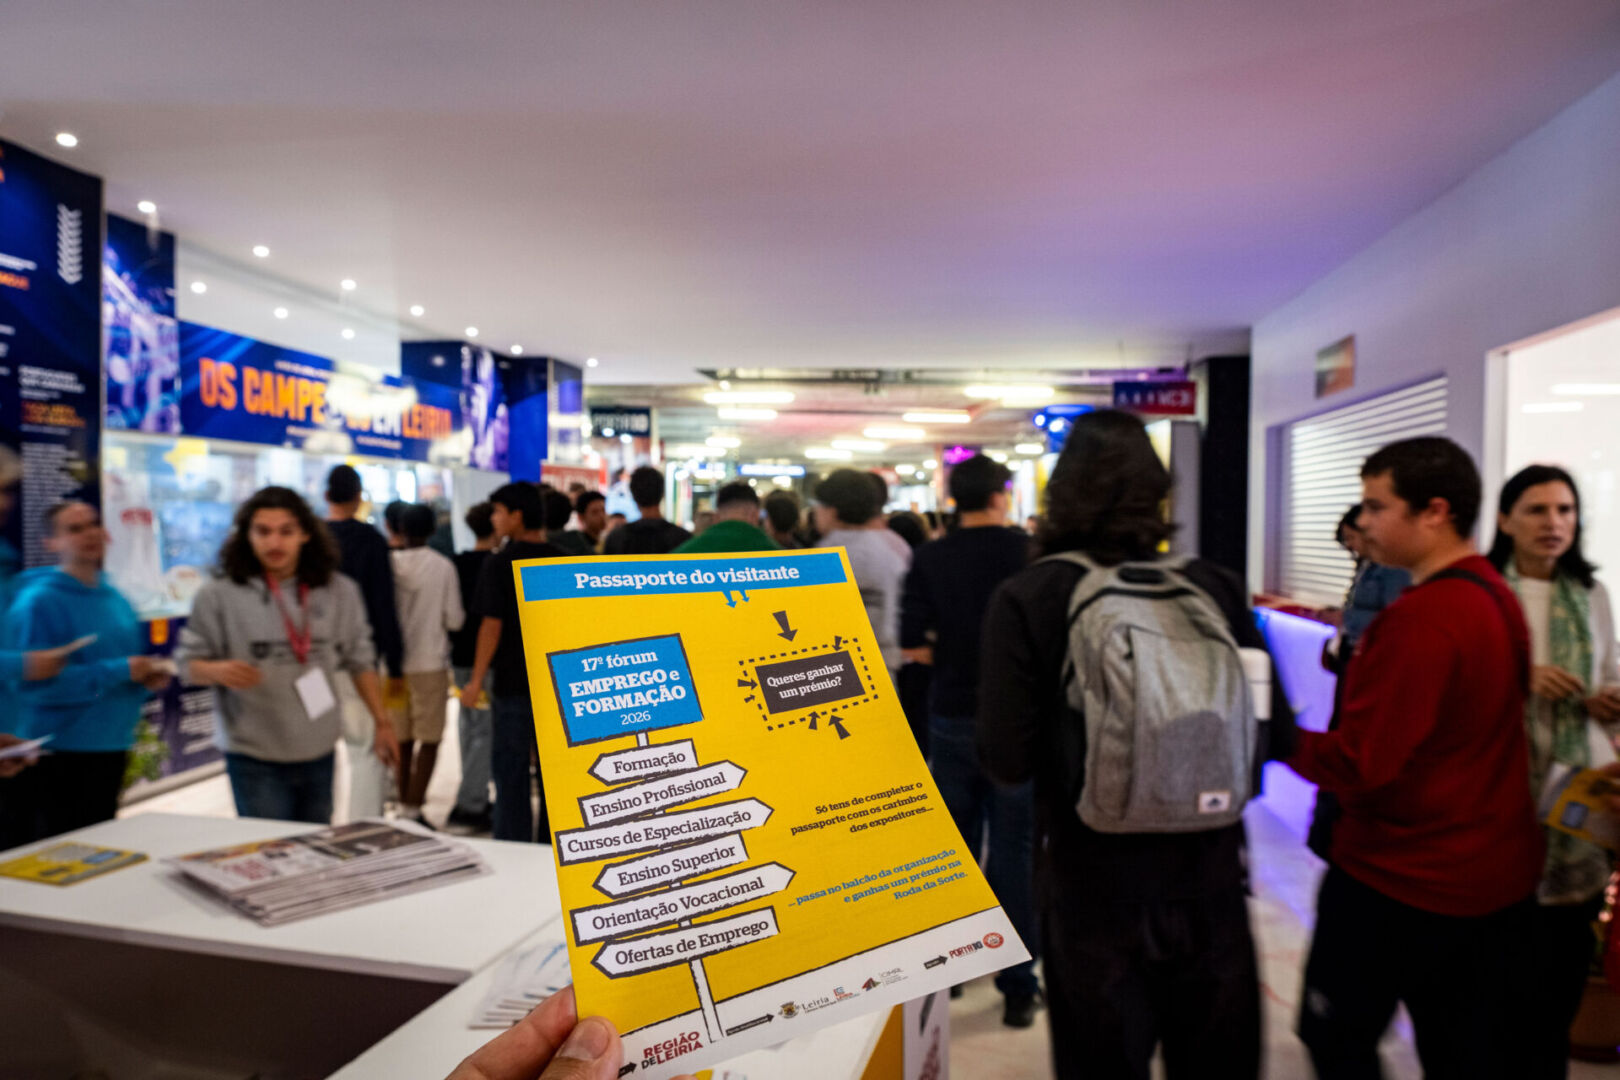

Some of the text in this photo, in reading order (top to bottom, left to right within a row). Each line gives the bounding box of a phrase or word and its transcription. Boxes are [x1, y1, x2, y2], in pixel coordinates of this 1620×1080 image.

[199, 357, 237, 411] OS
[574, 566, 800, 590] Passaporte do visitante
[581, 651, 658, 672] 17º fórum
[767, 663, 844, 688] Queres ganhar
[569, 668, 680, 697] EMPREGO e
[779, 676, 842, 699] um prémio?
[572, 684, 686, 717] FORMAÇÃO
[620, 710, 651, 725] 2026
[613, 752, 686, 773] Formação
[590, 772, 727, 817] Ensino Profissional
[815, 805, 828, 814] Só
[829, 800, 850, 811] tens
[851, 797, 864, 806] de
[865, 784, 914, 802] completar
[790, 793, 928, 836] passaporte com os carimbos
[849, 823, 868, 833] dos
[567, 810, 752, 853] Cursos de Especialização
[617, 845, 736, 886] Ensino Superior
[827, 884, 842, 894] no
[842, 873, 878, 889] balcão
[878, 869, 893, 879] da
[893, 848, 956, 873] organização
[843, 860, 962, 903] e ganhas um prémio na
[894, 871, 968, 900] Roda da Sorte.
[592, 877, 765, 930] Orientação Vocacional
[615, 921, 769, 965] Ofertas de Emprego
[801, 997, 830, 1010] Leiria
[643, 1031, 700, 1059] REGIÃO
